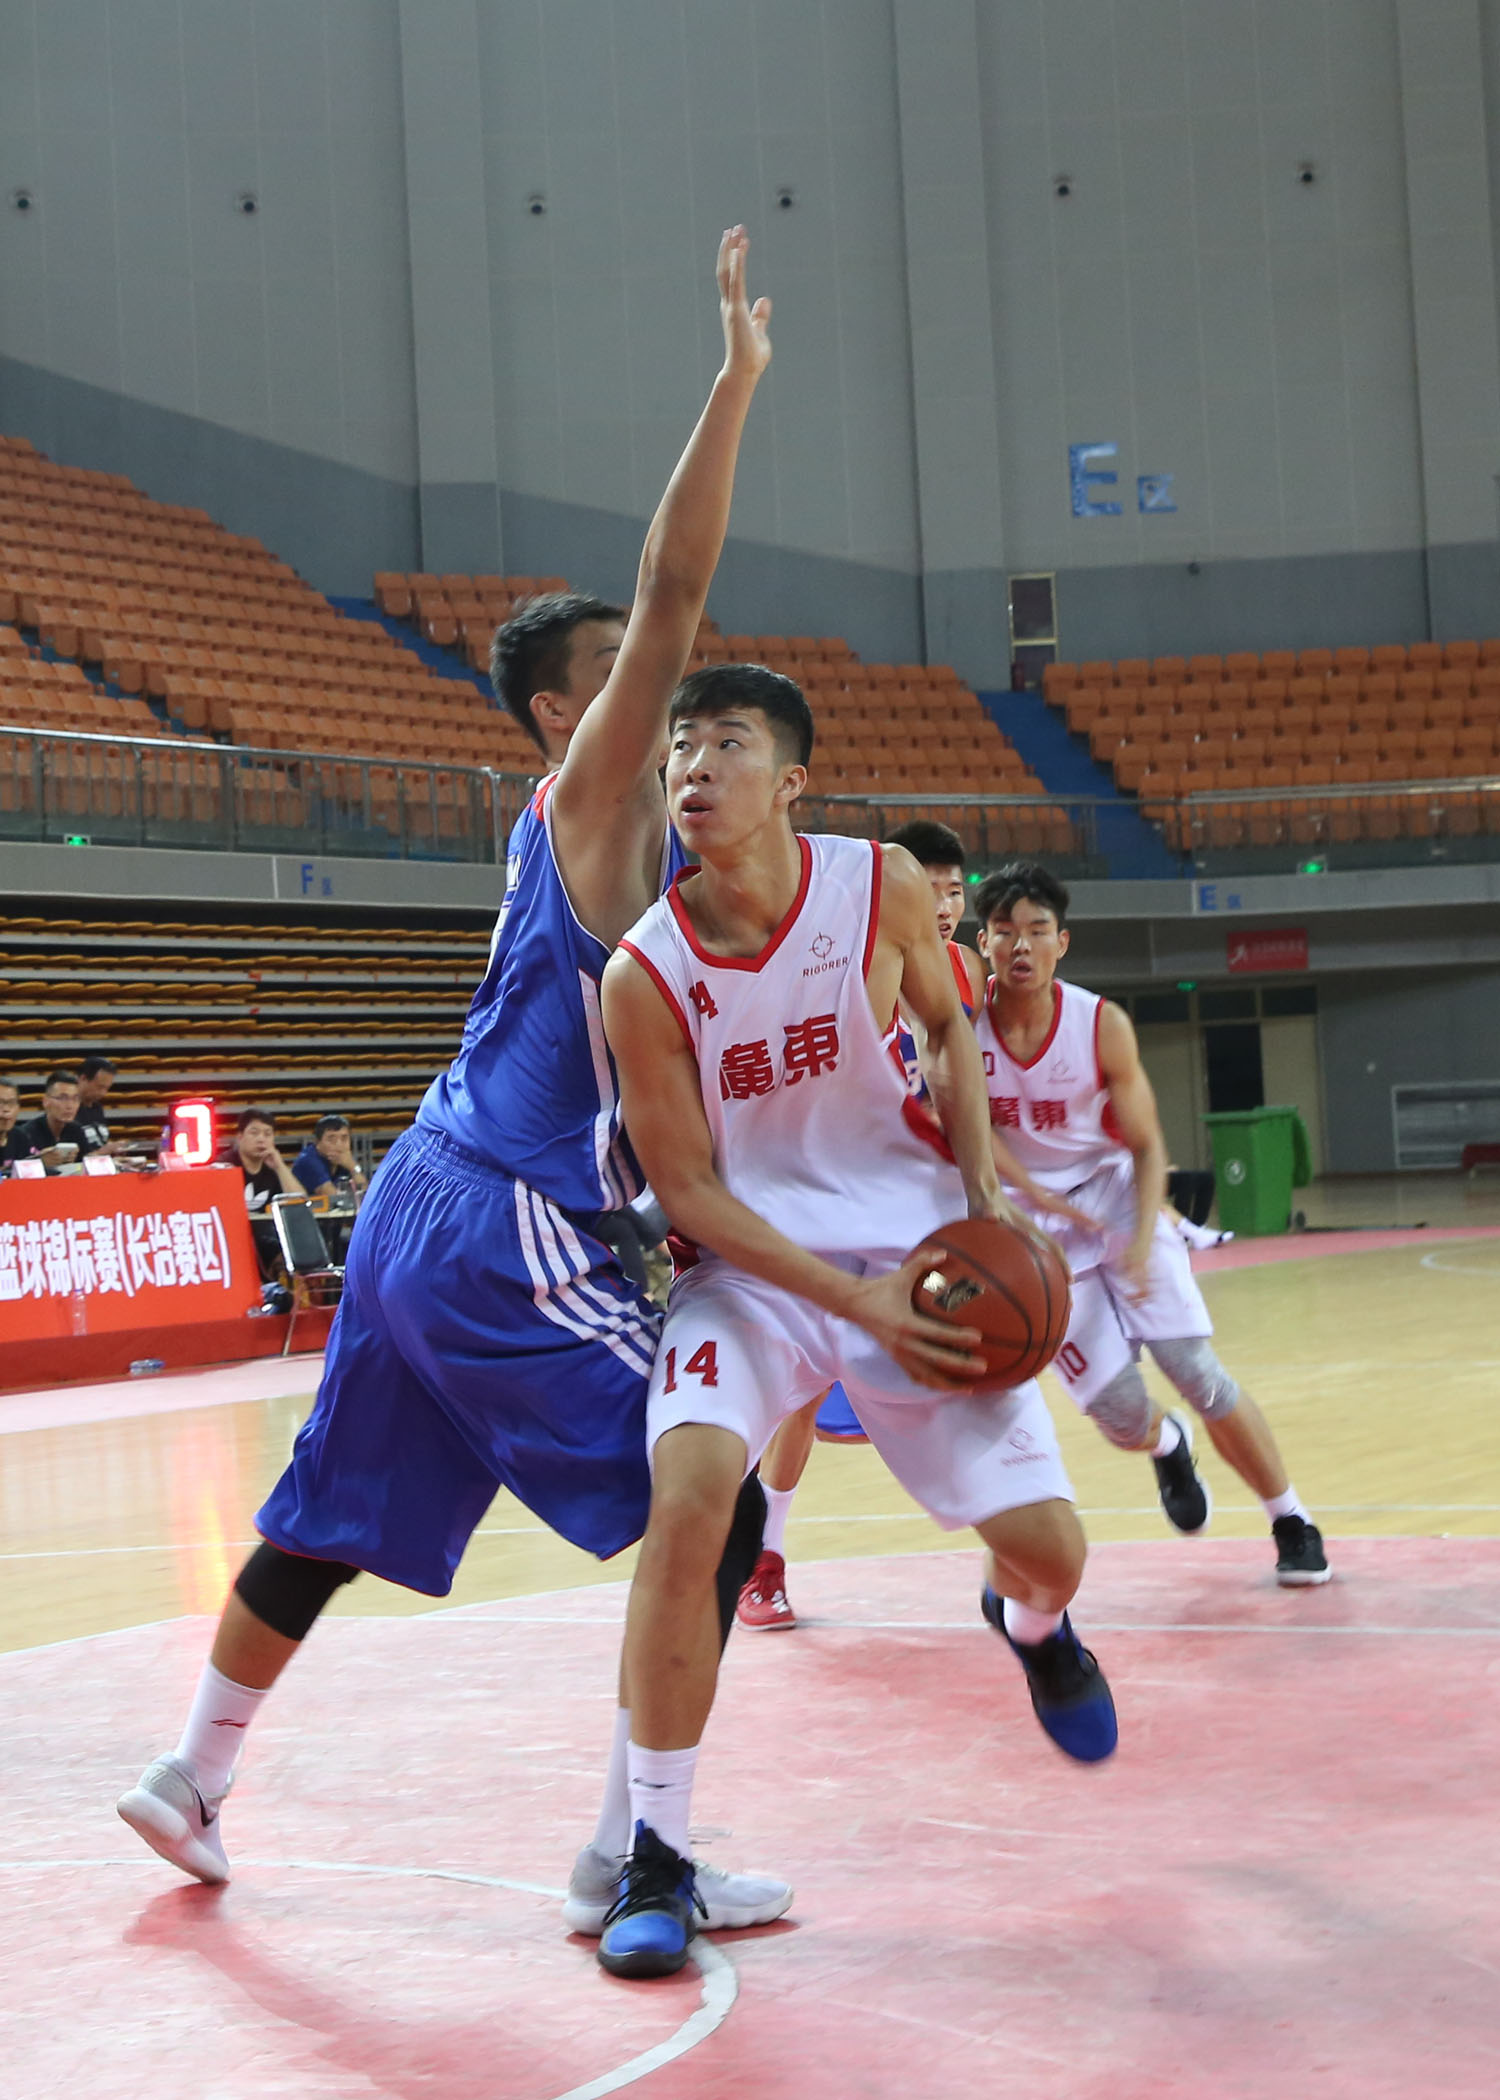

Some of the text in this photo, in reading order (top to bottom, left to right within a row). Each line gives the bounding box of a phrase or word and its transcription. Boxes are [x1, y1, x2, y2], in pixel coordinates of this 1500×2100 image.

[802, 956, 849, 978] RIGORER
[719, 1012, 841, 1102] 廣東
[663, 1340, 719, 1396] 14
